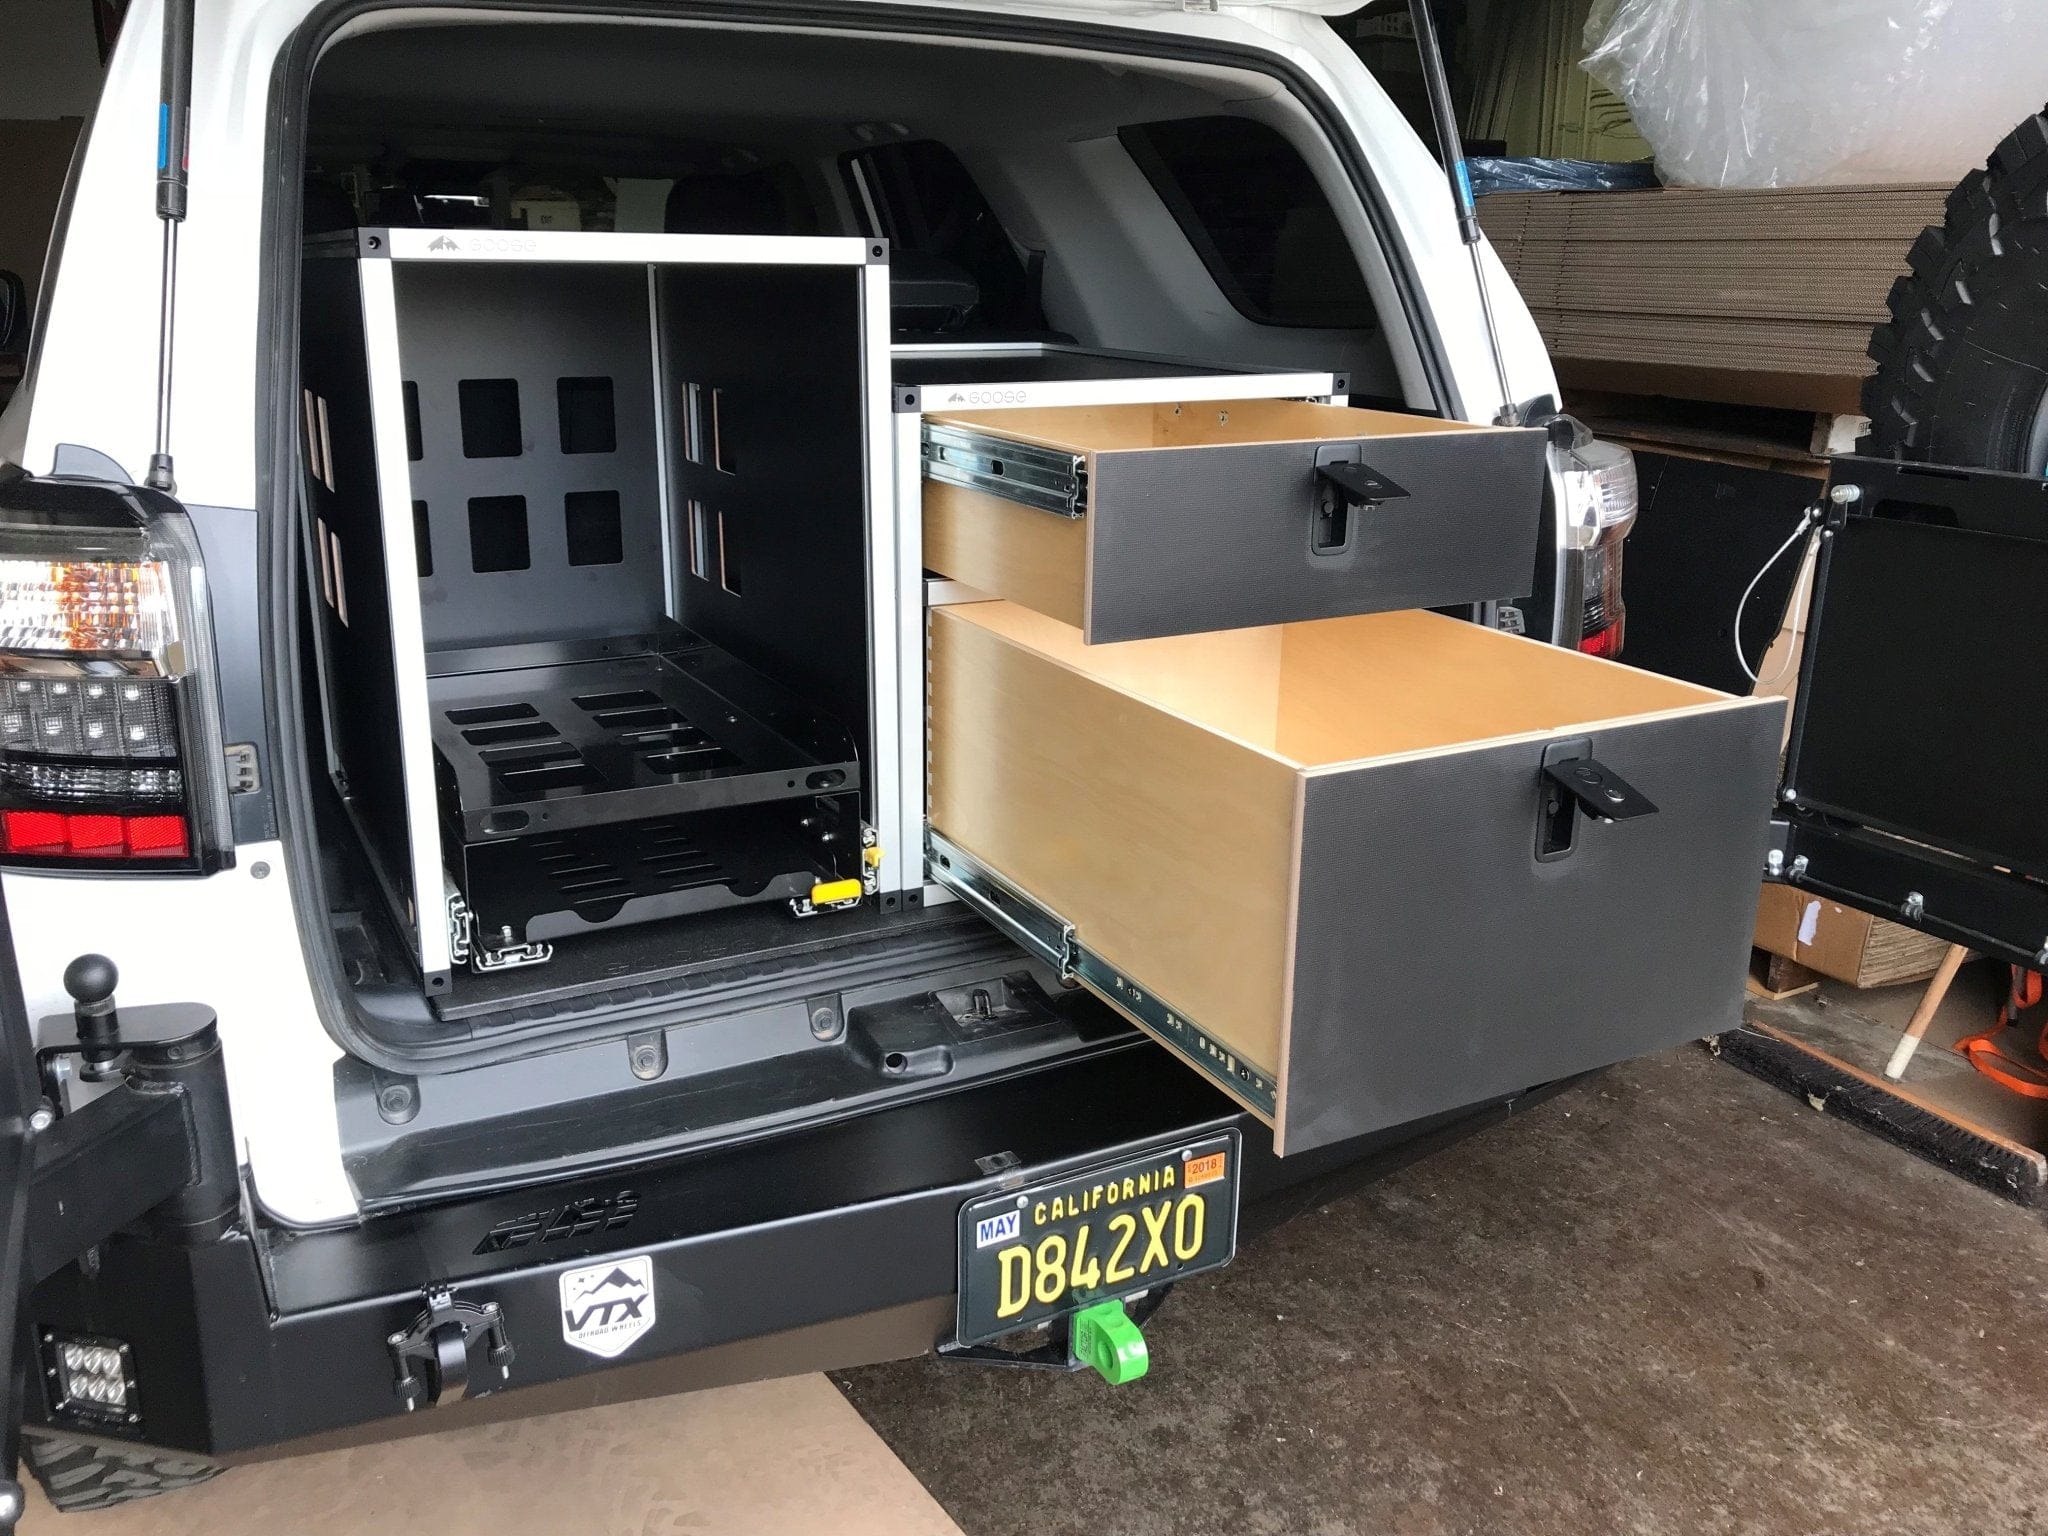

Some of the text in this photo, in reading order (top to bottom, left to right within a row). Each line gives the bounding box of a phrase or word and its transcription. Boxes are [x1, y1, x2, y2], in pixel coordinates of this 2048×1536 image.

[1191, 1158, 1217, 1175] 2018
[1034, 1165, 1176, 1226] CALIFORNIA
[979, 1214, 1017, 1243] MAY
[564, 1293, 649, 1333] VTX
[578, 1320, 642, 1339] OFFROAD WHEELS
